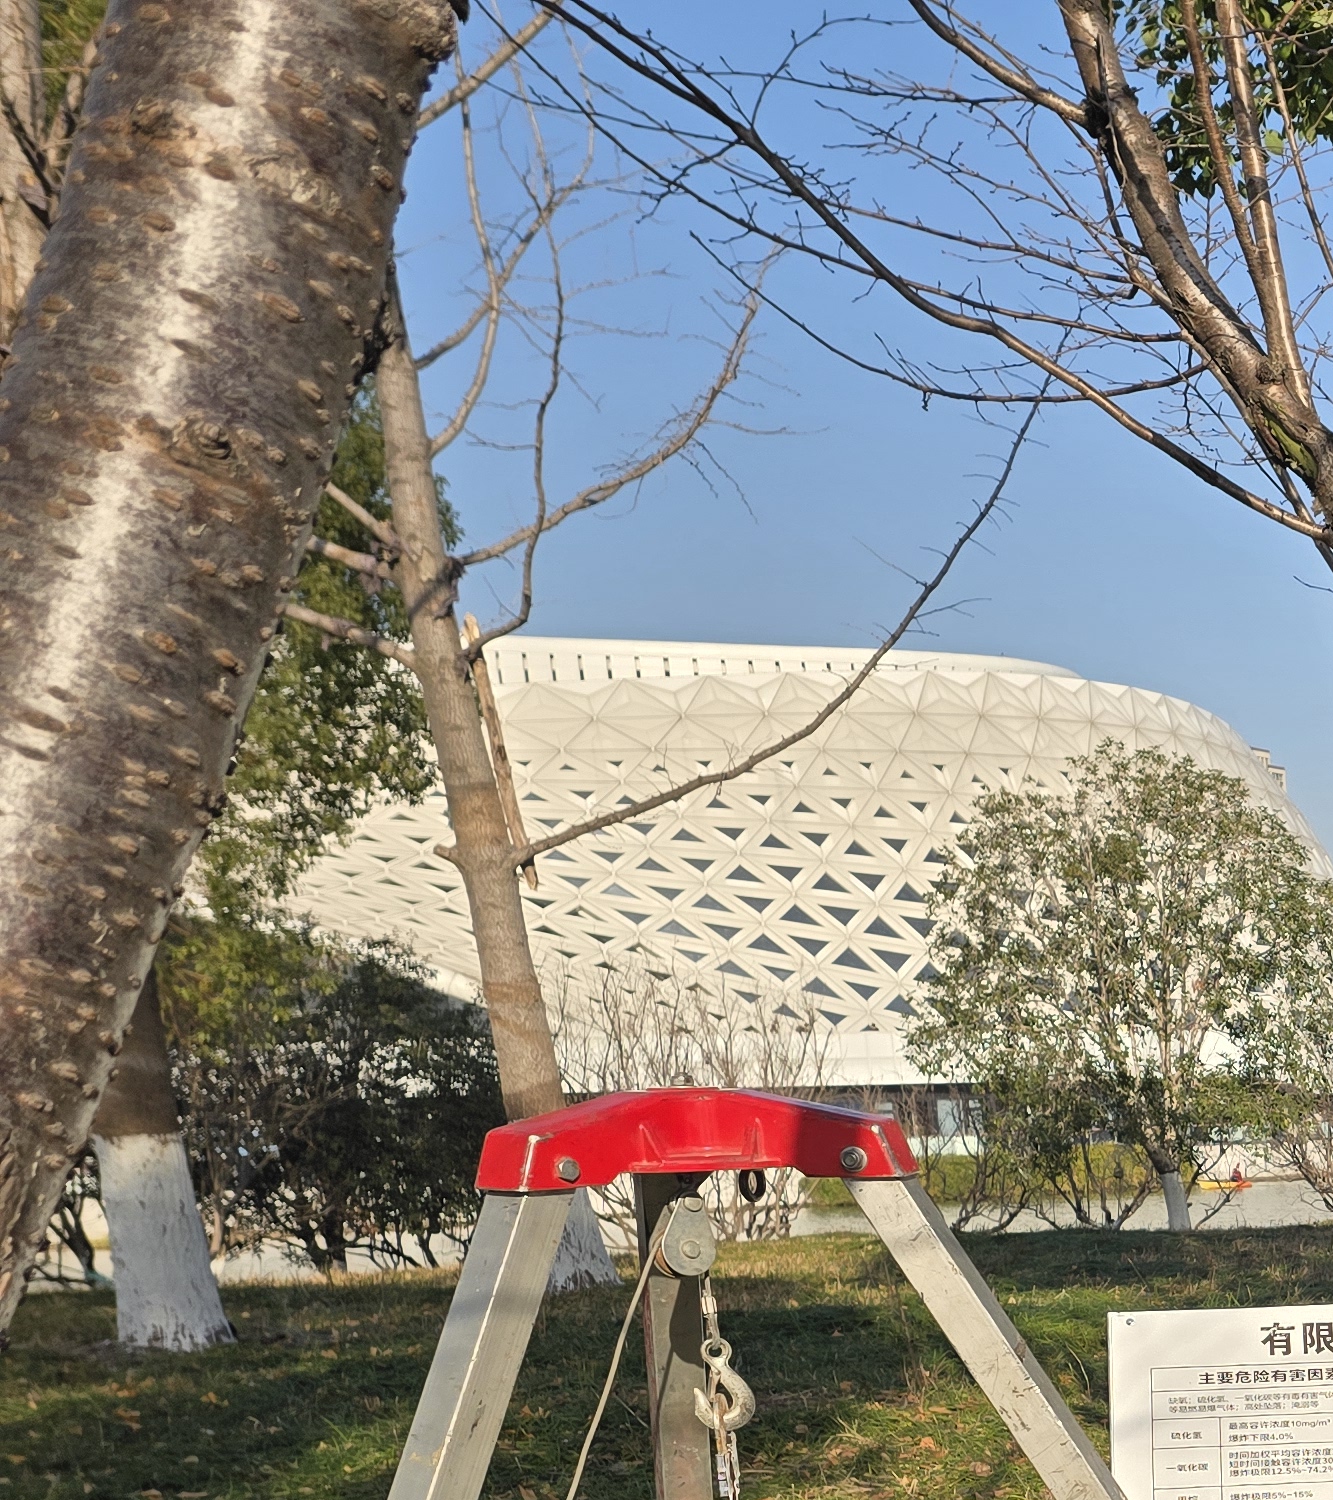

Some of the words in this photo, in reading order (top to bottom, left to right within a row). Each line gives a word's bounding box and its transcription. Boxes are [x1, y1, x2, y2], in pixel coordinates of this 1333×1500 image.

[1171, 1431, 1203, 1440] 硫化氢
[1229, 1432, 1294, 1443] 爆炸下限4.0%
[1166, 1462, 1209, 1472] 一氧化碳
